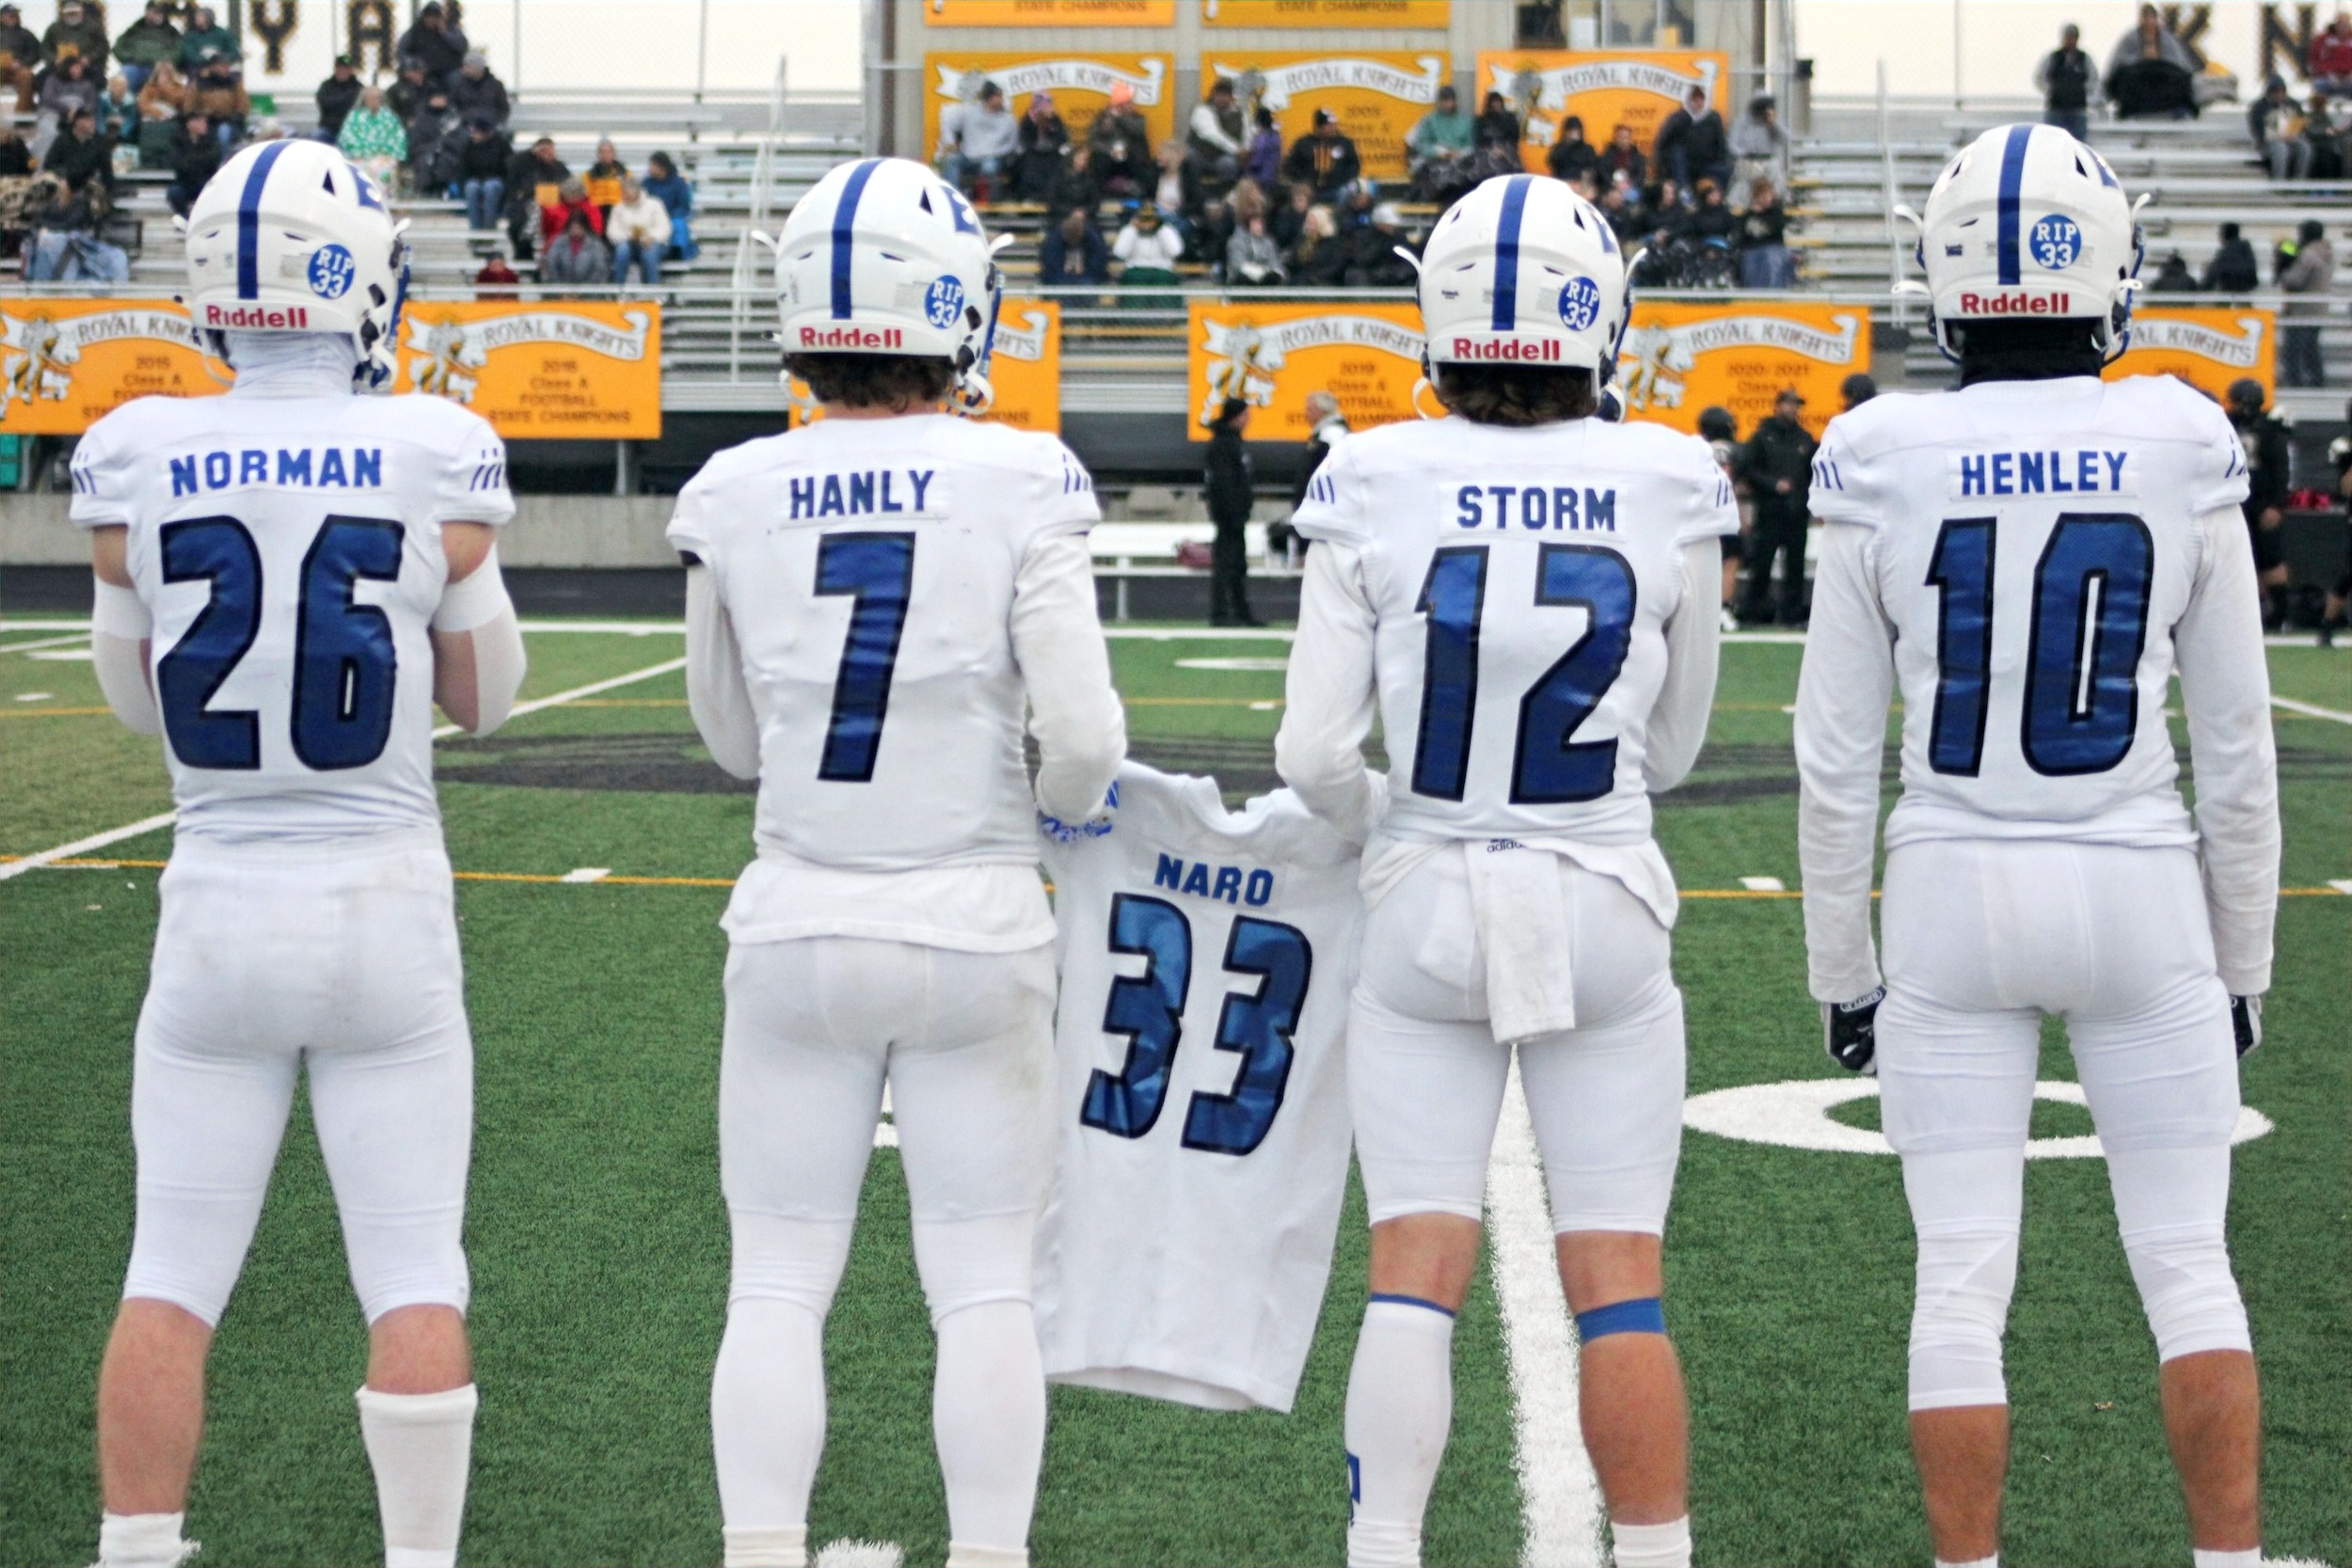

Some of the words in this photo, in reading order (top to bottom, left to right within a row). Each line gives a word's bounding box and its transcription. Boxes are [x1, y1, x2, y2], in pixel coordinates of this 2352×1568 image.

[1009, 67, 1066, 90] ROYAL
[1285, 66, 1344, 91] ROYAL
[1352, 67, 1430, 100] KNIGHTS
[1563, 67, 1620, 91] ROYAL
[1628, 68, 1684, 95] KNIGH
[2036, 222, 2077, 242] RIP
[316, 248, 354, 276] RIP
[2040, 243, 2073, 268] 33
[312, 269, 345, 298] 33
[932, 280, 963, 303] RIP
[1566, 280, 1598, 308] RIP
[206, 305, 308, 328] Riddell
[930, 301, 956, 328] 33
[1563, 302, 1592, 330] 33
[1961, 293, 2069, 314] Riddell
[78, 313, 136, 342] ROYAL
[485, 317, 549, 345] ROYAL
[556, 321, 639, 357] KNIGHTS
[800, 327, 902, 349] Riddell
[1281, 322, 1343, 347] ROYAL
[1352, 323, 1424, 356] KNIGHT
[1690, 322, 1754, 347] ROYAL
[1762, 324, 1847, 358] KNIGHTS
[1453, 338, 1561, 361] Riddell
[2168, 325, 2252, 361] KNIGHTS
[172, 374, 182, 385] A
[580, 377, 589, 388] A
[1376, 379, 1386, 390] A
[520, 393, 596, 406] FOOTBALL
[488, 410, 532, 421] STATE
[539, 410, 631, 422] CHAMPIONS
[170, 448, 383, 497] NORMAN
[1961, 451, 2128, 497] HENLEY
[789, 469, 934, 519] HANLY
[1457, 485, 1616, 531] STORM
[158, 514, 405, 771] 26
[1924, 512, 2154, 778] 10
[814, 531, 916, 784] 7
[1412, 542, 1637, 804] 12
[1153, 852, 1274, 907] NARO
[1080, 892, 1312, 1156] 33
